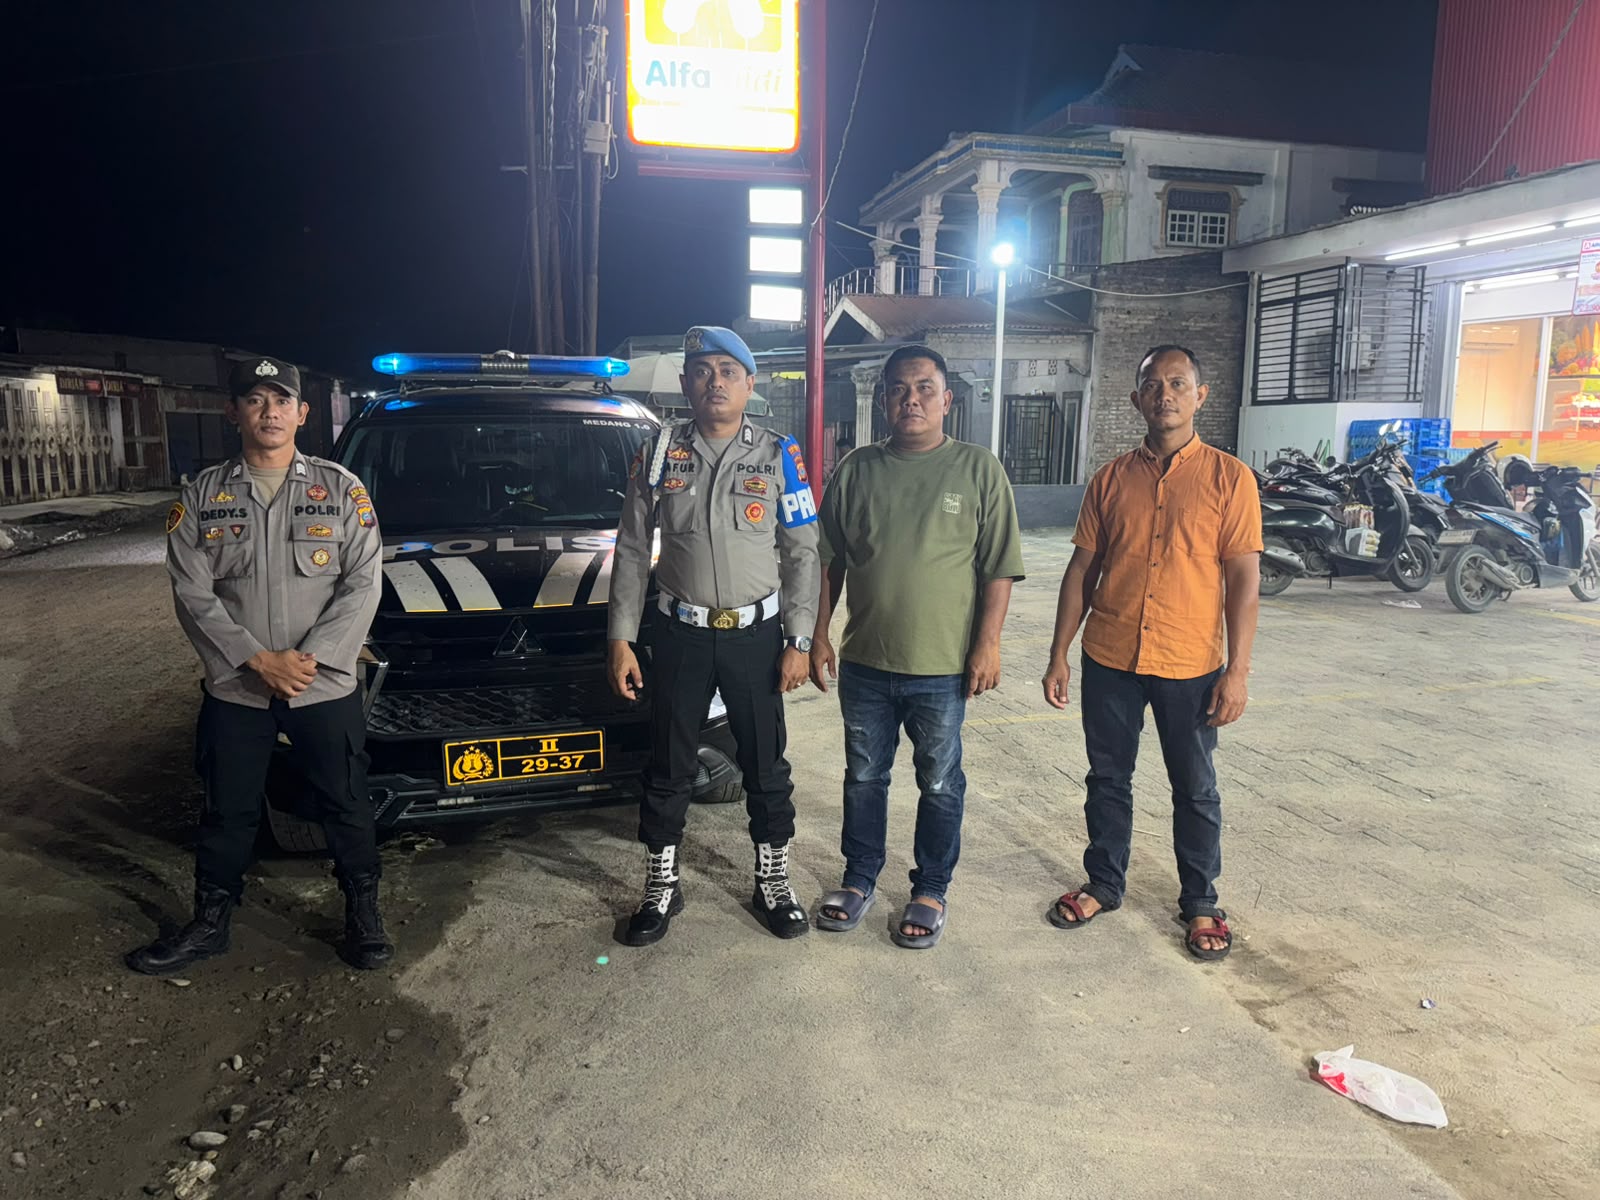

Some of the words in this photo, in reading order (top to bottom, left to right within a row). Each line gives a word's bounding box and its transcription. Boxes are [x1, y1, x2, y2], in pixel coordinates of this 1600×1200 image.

[582, 419, 632, 428] MEDANG
[736, 463, 776, 476] POLRI
[200, 508, 248, 521] DEDY.S
[294, 505, 340, 516] POLRI
[538, 738, 559, 753] II
[521, 754, 585, 773] 29-37
